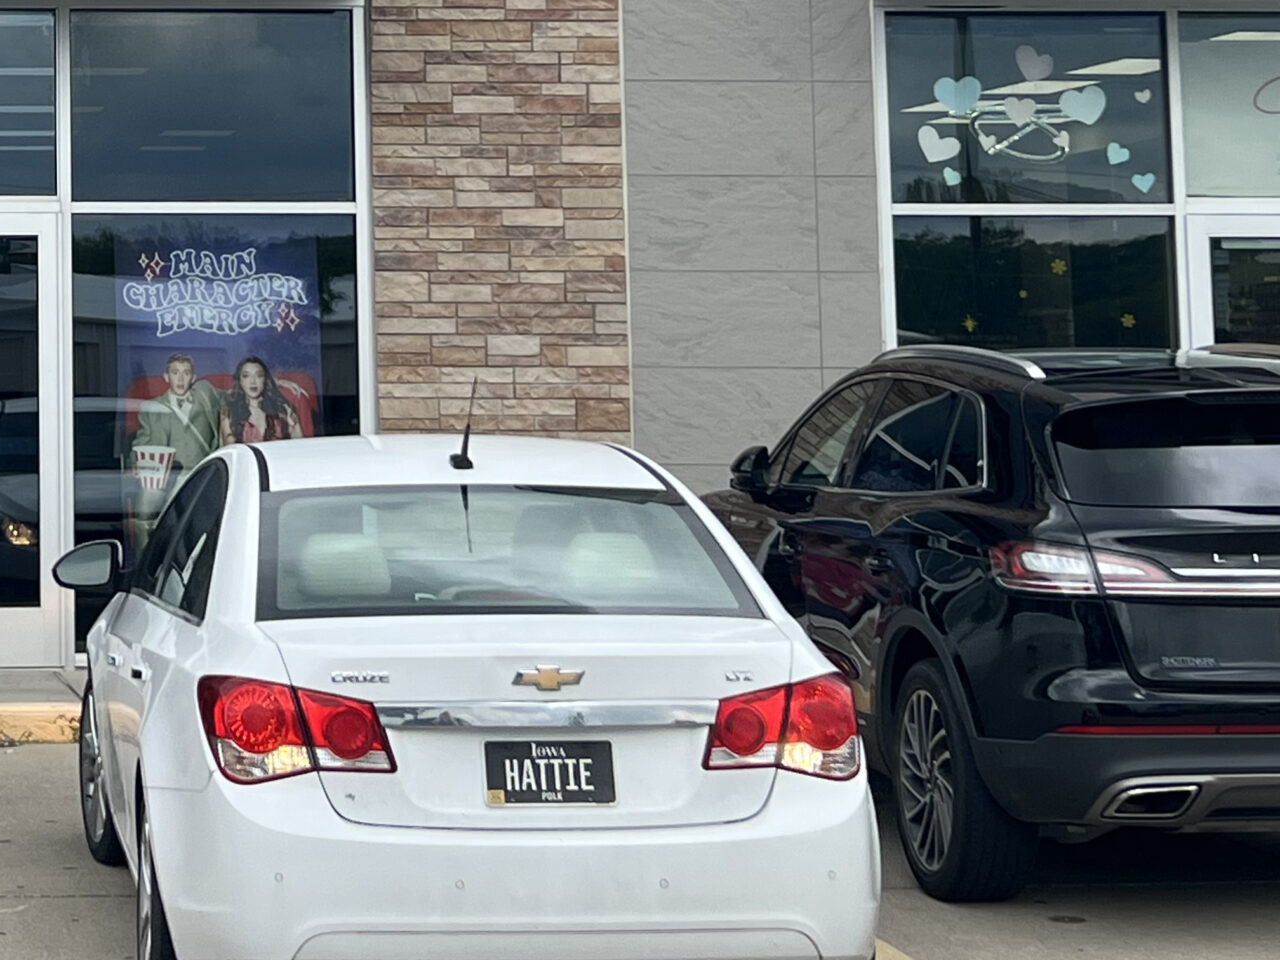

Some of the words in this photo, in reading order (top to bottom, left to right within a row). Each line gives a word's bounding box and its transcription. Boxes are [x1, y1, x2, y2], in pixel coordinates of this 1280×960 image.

[170, 248, 256, 280] MAIN
[123, 273, 308, 311] CHARACTER
[156, 301, 274, 337] ENERGY
[331, 671, 390, 683] CRUZE
[504, 758, 595, 791] HATTIE
[541, 791, 563, 802] POLK
